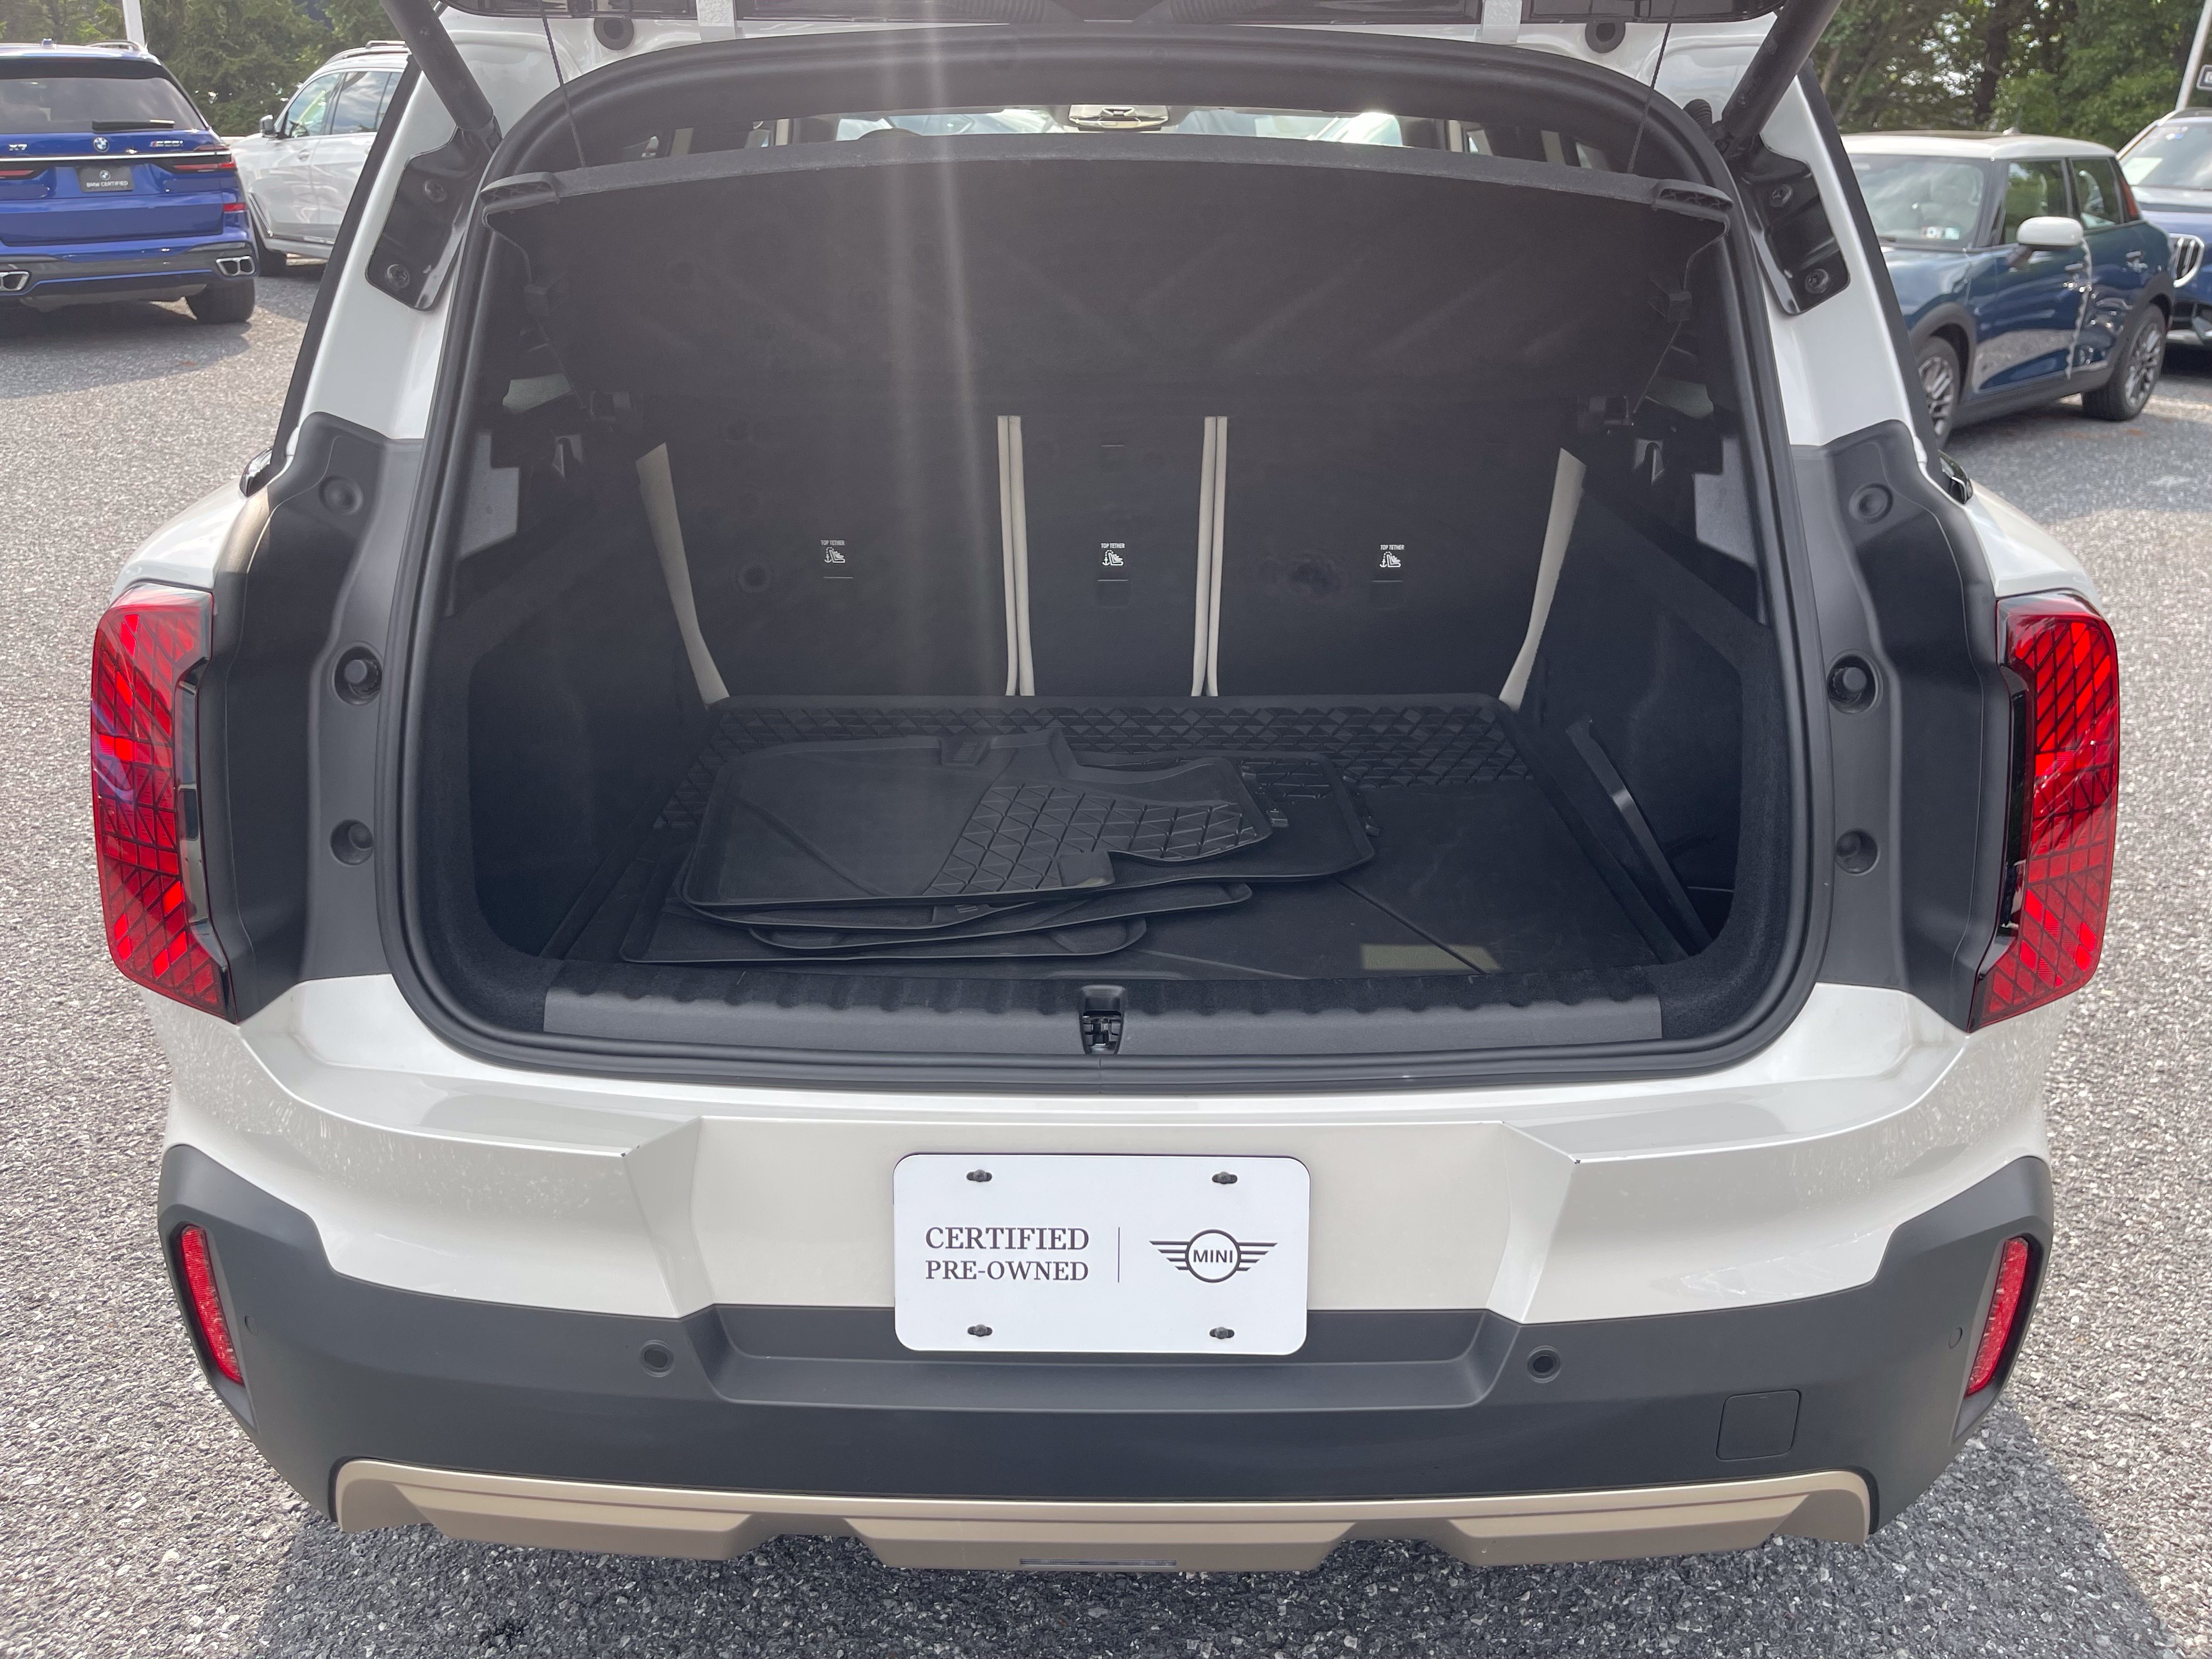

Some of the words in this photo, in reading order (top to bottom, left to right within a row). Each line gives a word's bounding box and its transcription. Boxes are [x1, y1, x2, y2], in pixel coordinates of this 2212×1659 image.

[926, 1226, 1089, 1250] CERTIFIED
[1193, 1249, 1233, 1263] MINI
[926, 1260, 1089, 1280] PRE-OWNED
